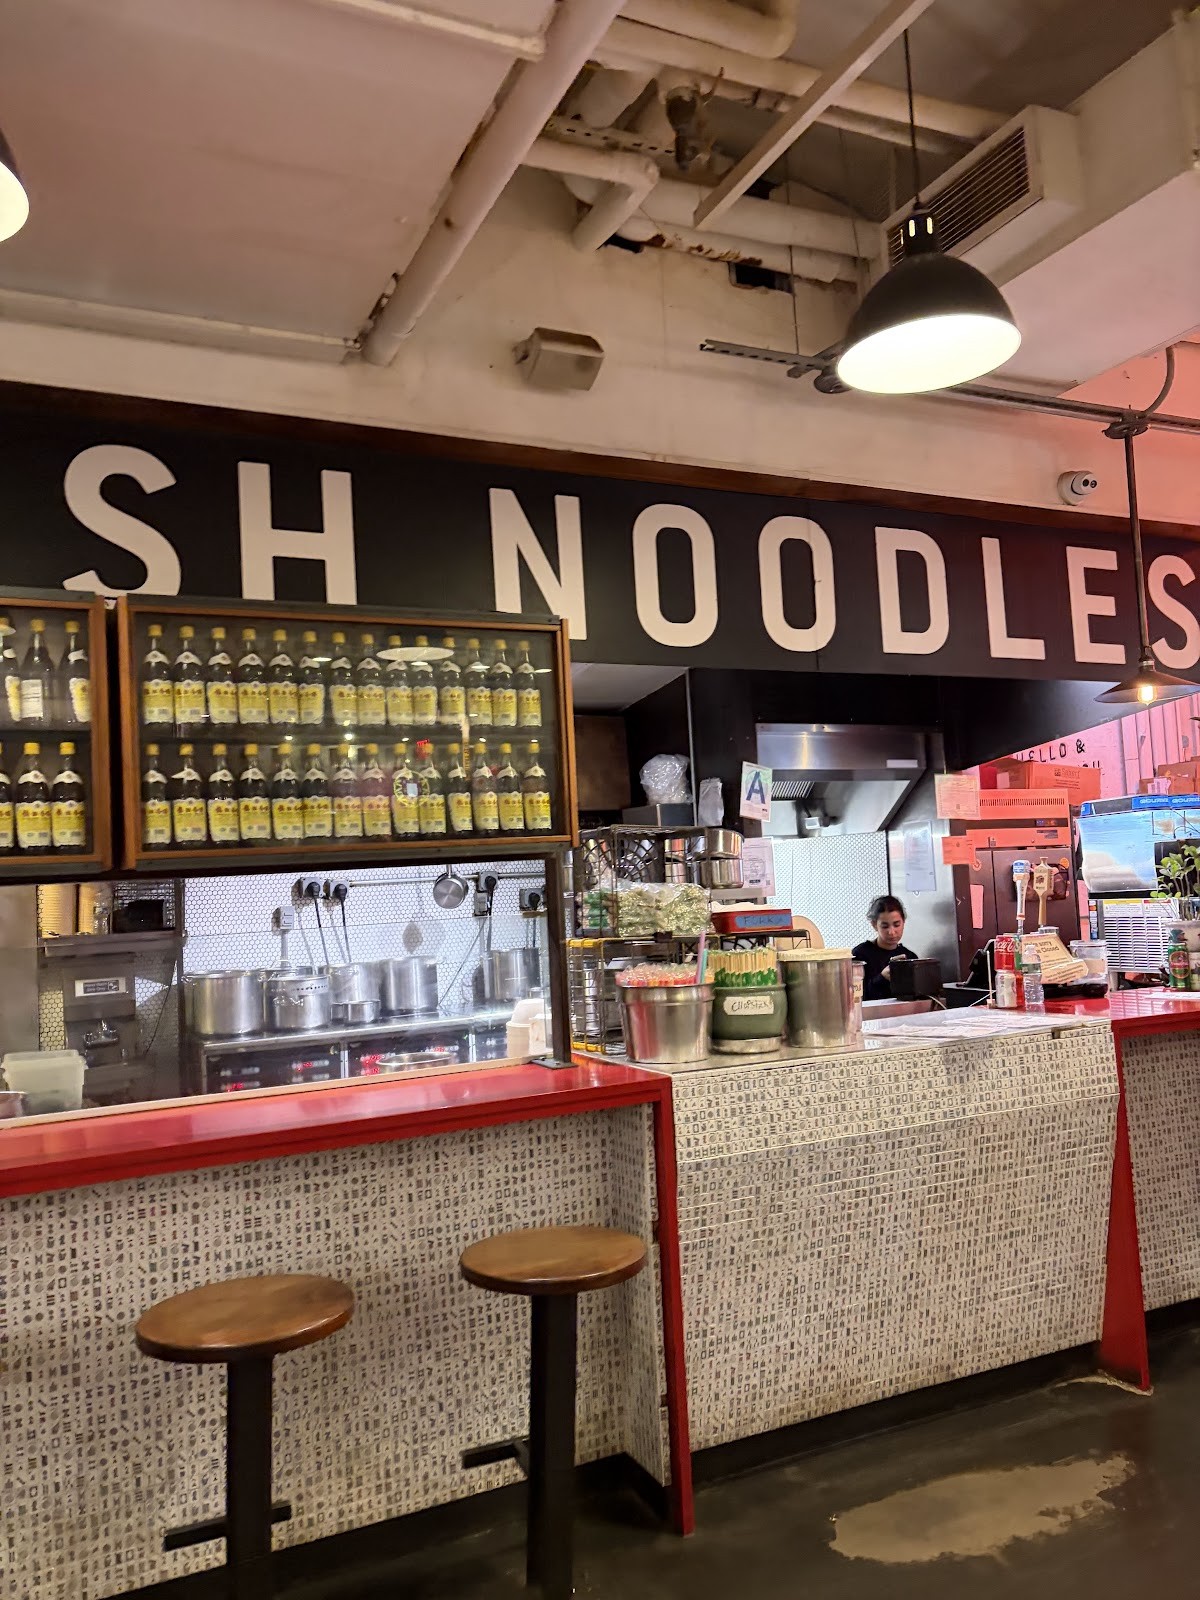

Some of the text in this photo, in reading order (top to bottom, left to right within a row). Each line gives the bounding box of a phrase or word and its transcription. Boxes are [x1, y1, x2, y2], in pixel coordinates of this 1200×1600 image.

[63, 444, 1200, 670] SH NOODLES
[1075, 739, 1086, 754] &
[745, 771, 767, 805] A
